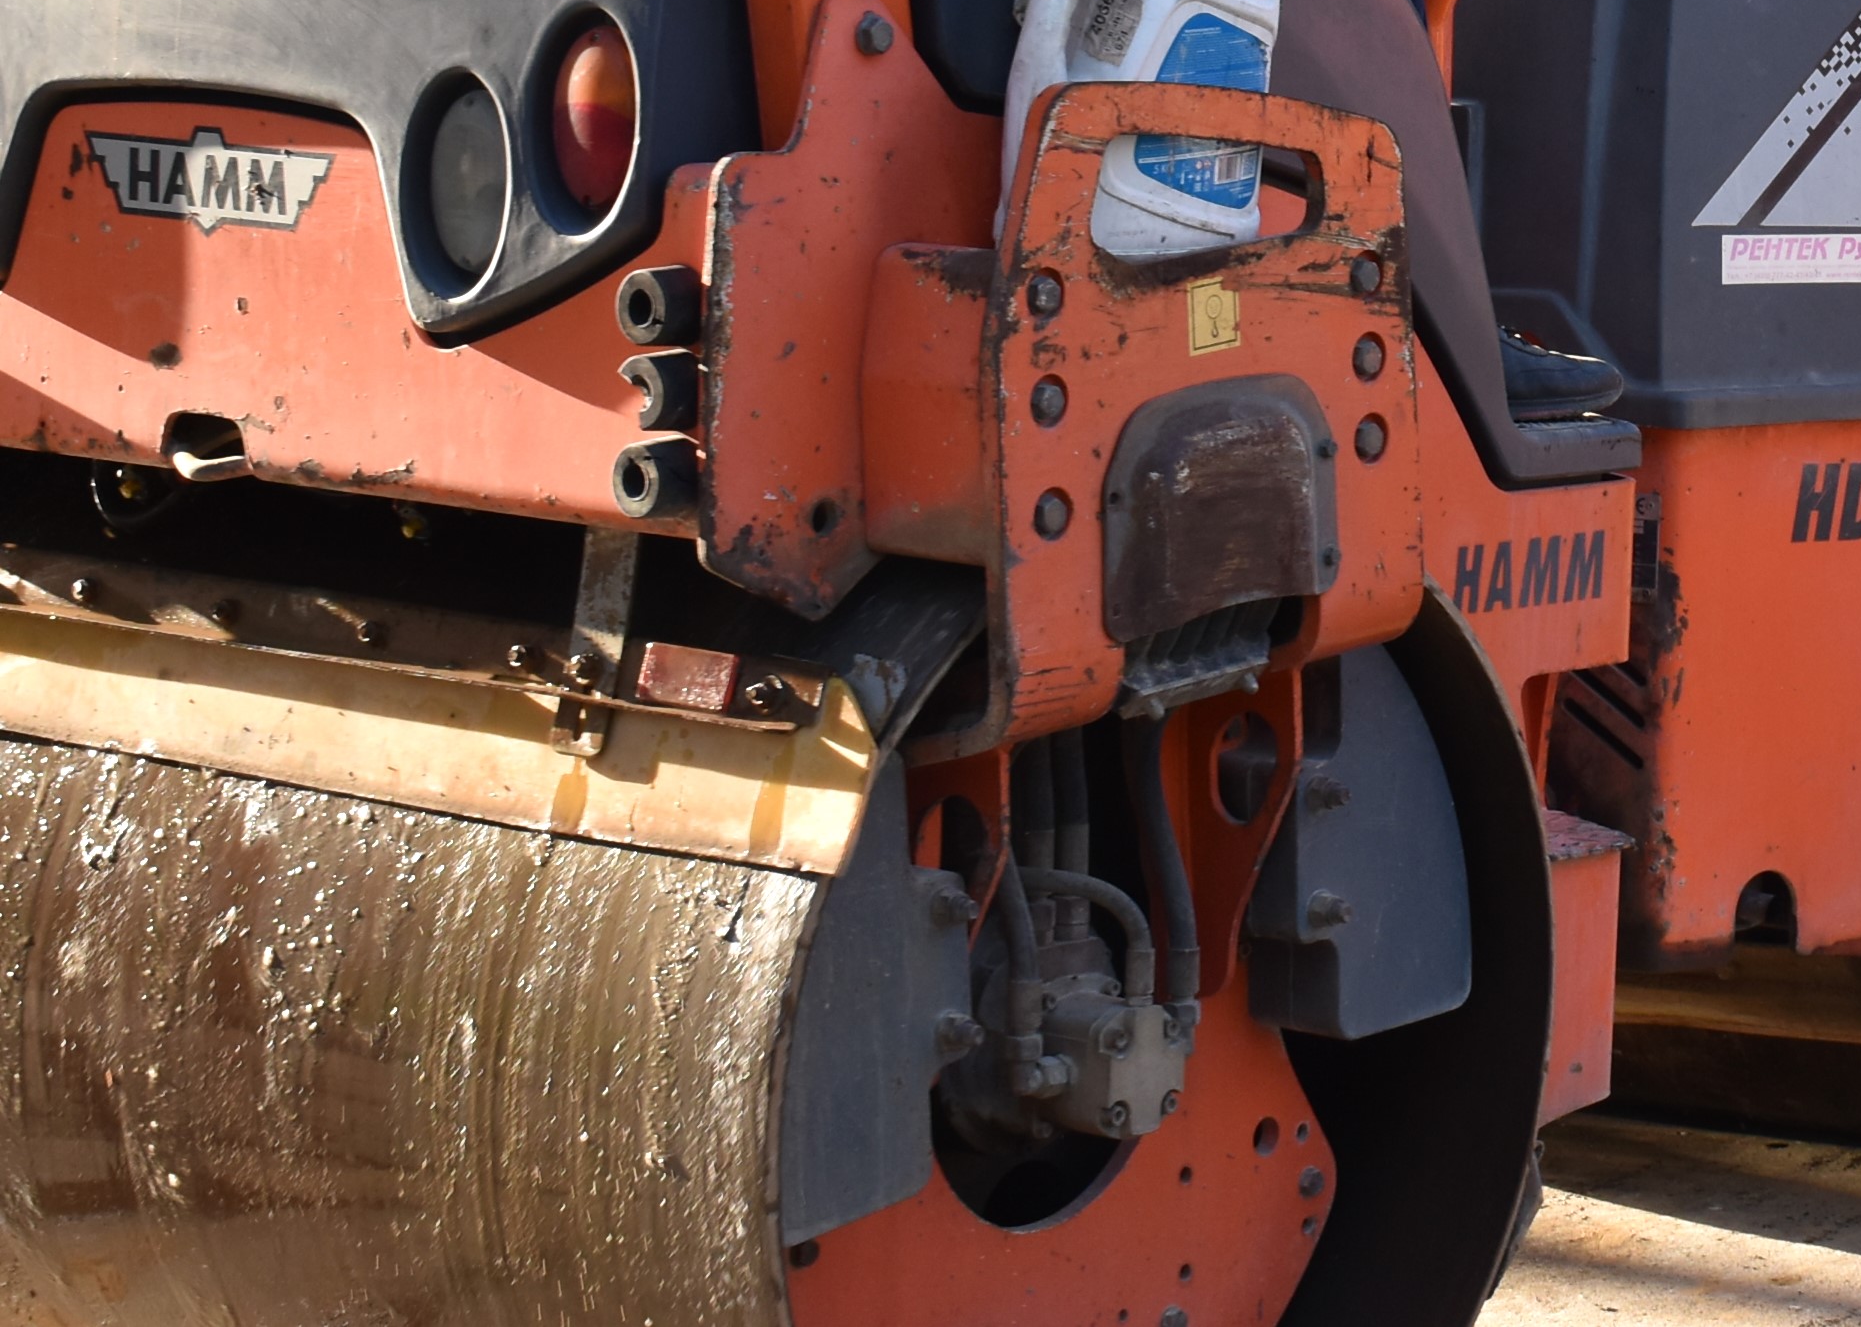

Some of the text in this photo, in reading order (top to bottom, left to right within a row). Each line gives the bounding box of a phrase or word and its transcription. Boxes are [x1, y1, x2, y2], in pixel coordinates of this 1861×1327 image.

[128, 147, 287, 216] HAMM
[1730, 237, 1830, 261] РЕНТЕК
[1453, 530, 1605, 614] HAMM
